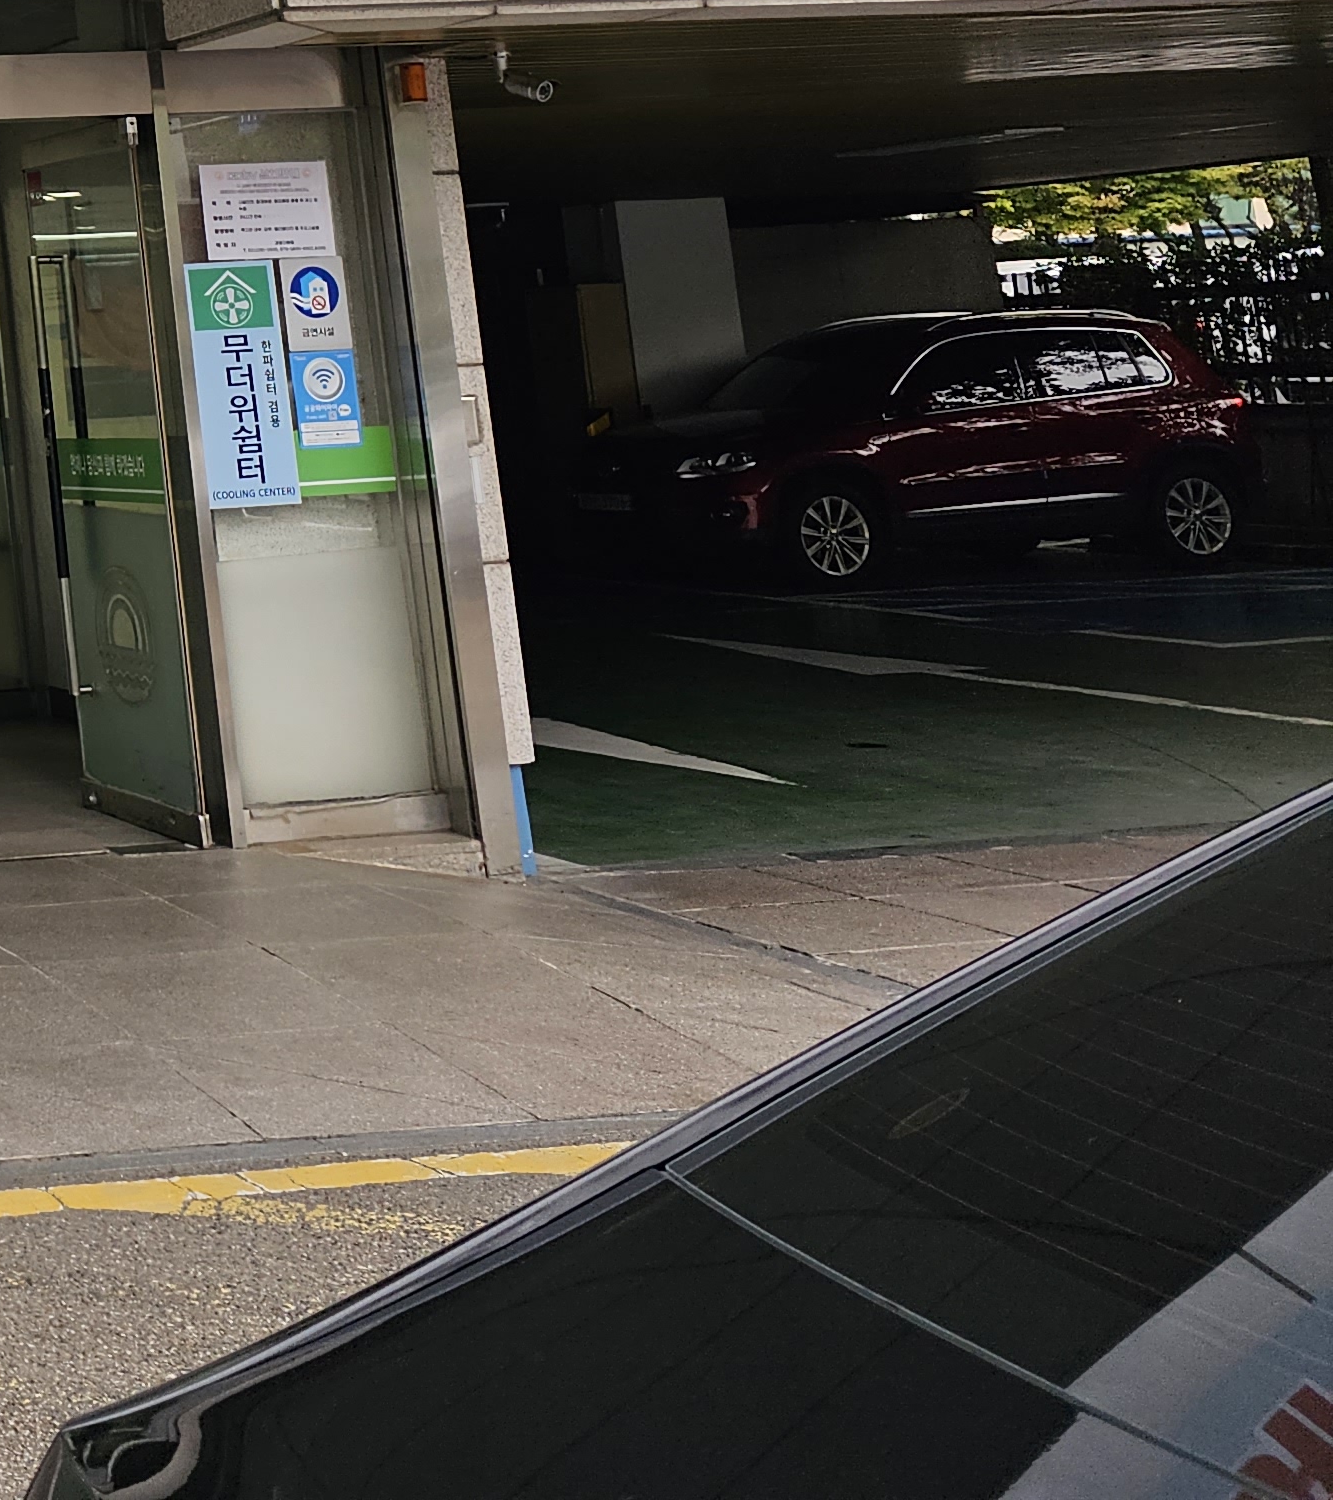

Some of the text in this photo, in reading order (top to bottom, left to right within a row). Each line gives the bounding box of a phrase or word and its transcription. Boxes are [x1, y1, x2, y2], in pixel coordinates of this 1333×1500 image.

[301, 326, 335, 338] 금연시설
[260, 339, 278, 396] 한파쉼터
[220, 334, 266, 484] 무더위쉼터
[212, 486, 296, 501] (COOLING CENTER)
